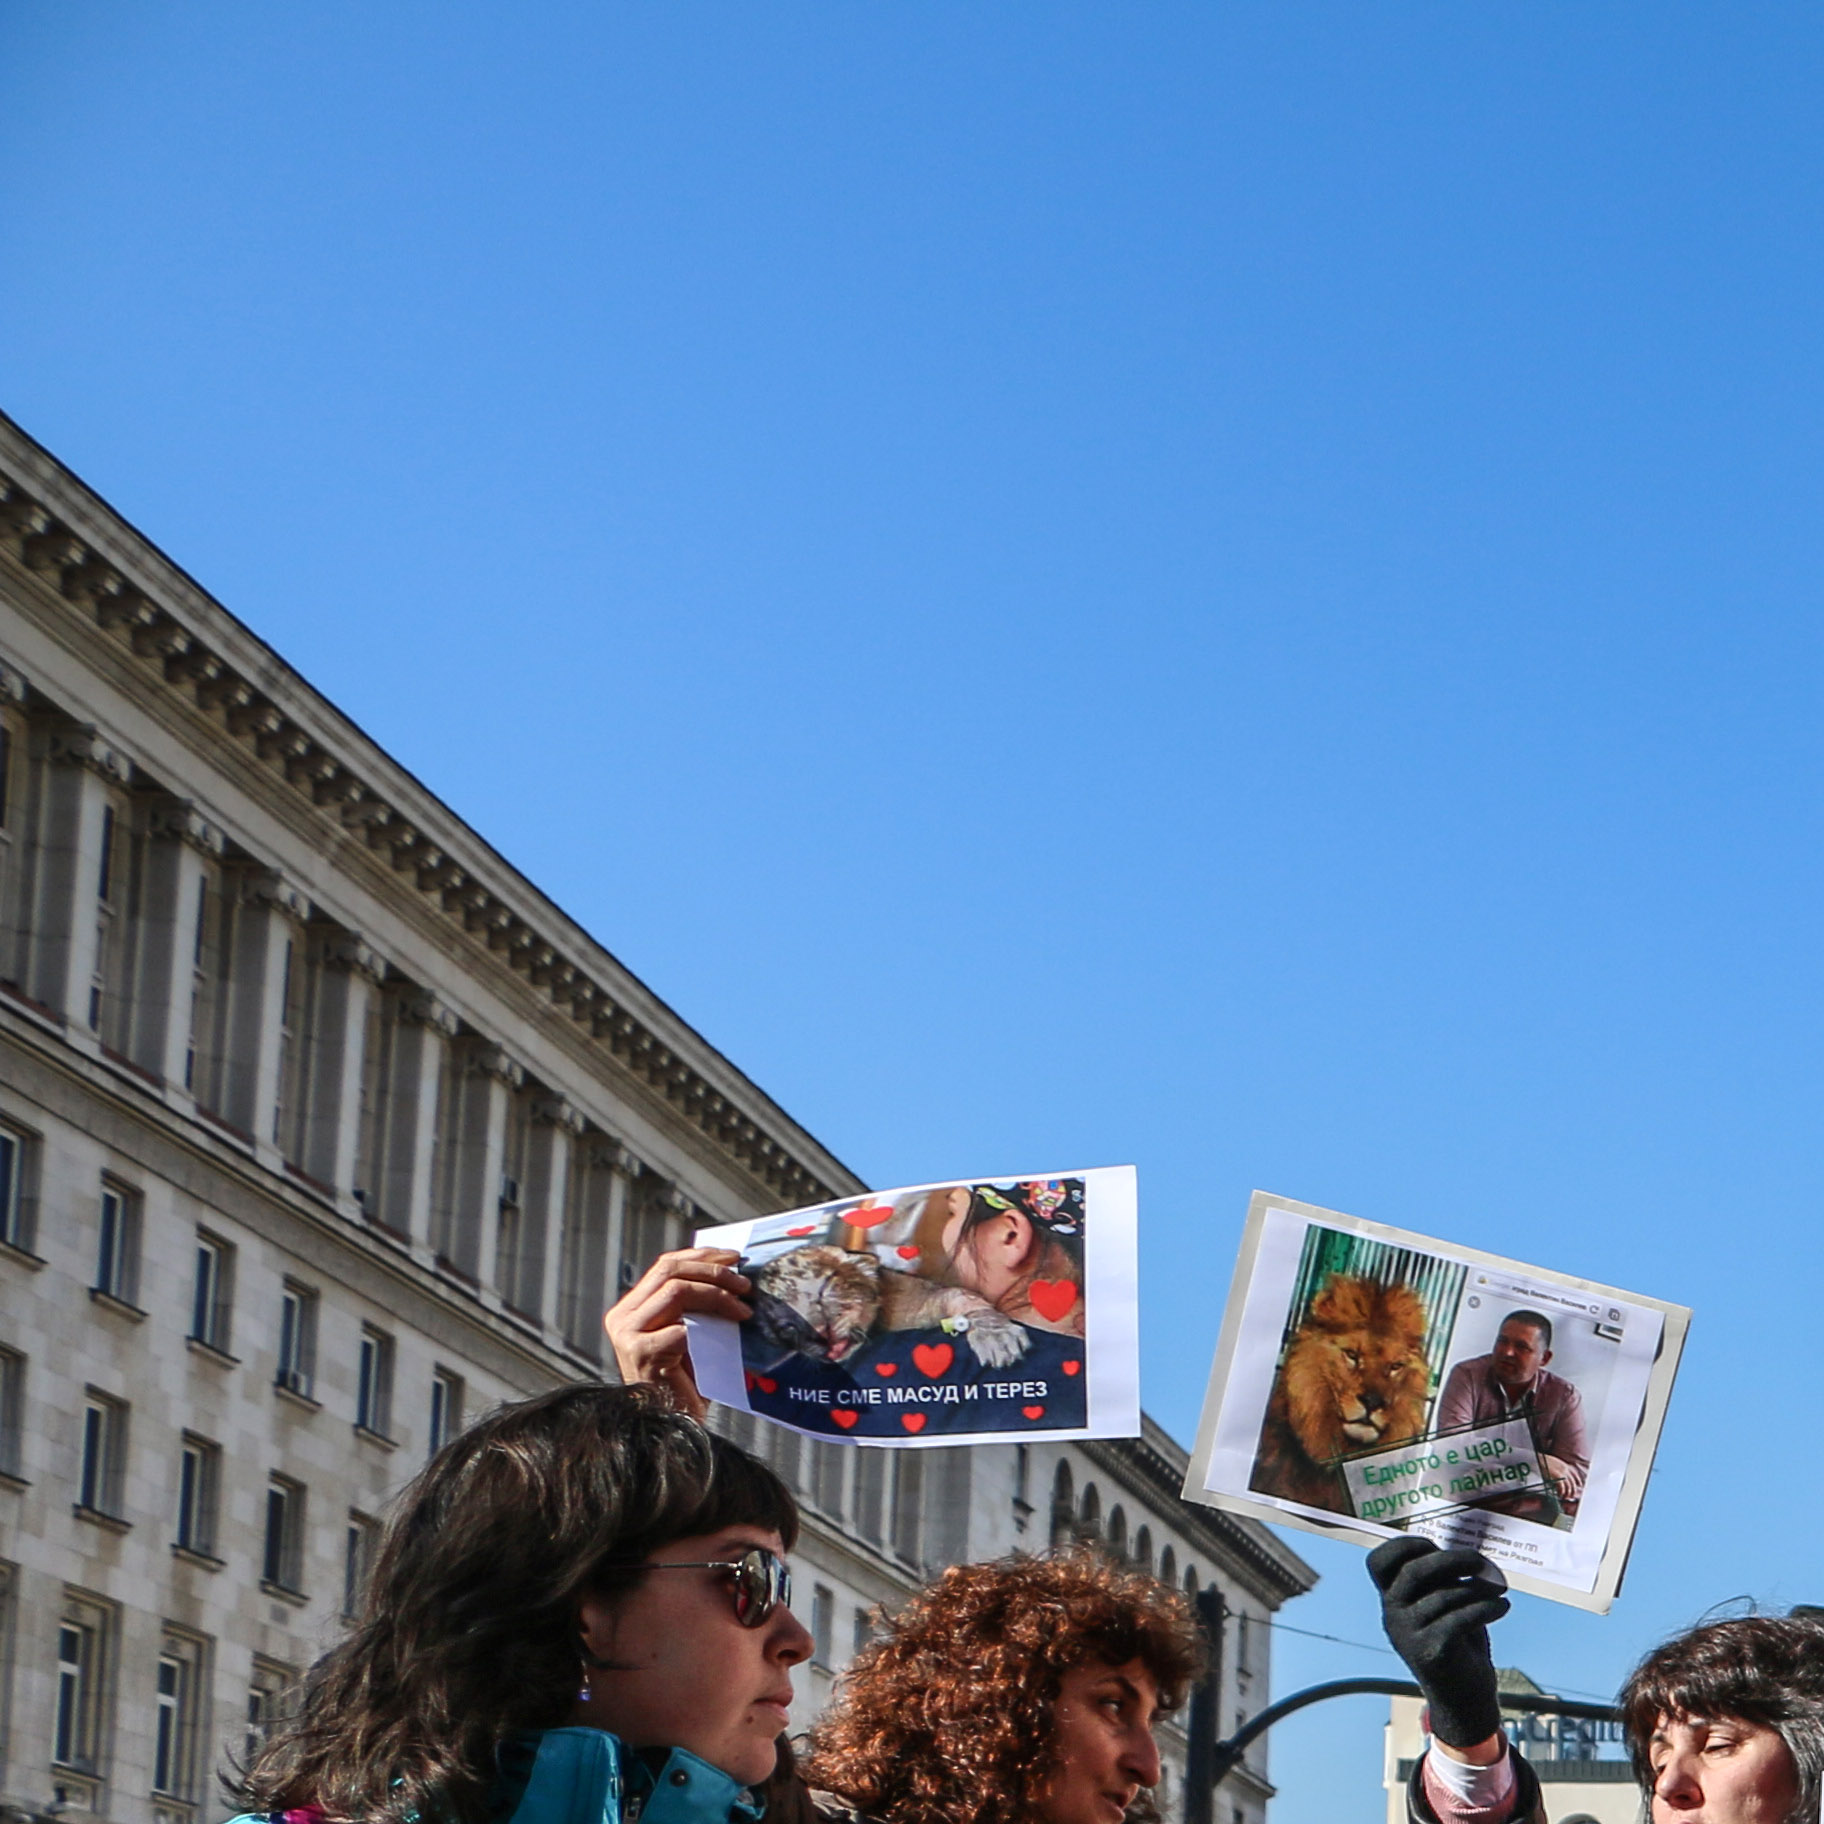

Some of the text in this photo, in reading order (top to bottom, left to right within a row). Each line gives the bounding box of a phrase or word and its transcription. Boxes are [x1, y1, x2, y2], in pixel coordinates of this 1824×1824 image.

[789, 1380, 1048, 1405] НИЕ СМЕ МАСУД И ТЕРЕЗ
[1363, 1437, 1514, 1487] Едното е цар,
[1360, 1460, 1532, 1520] другото лайнар
